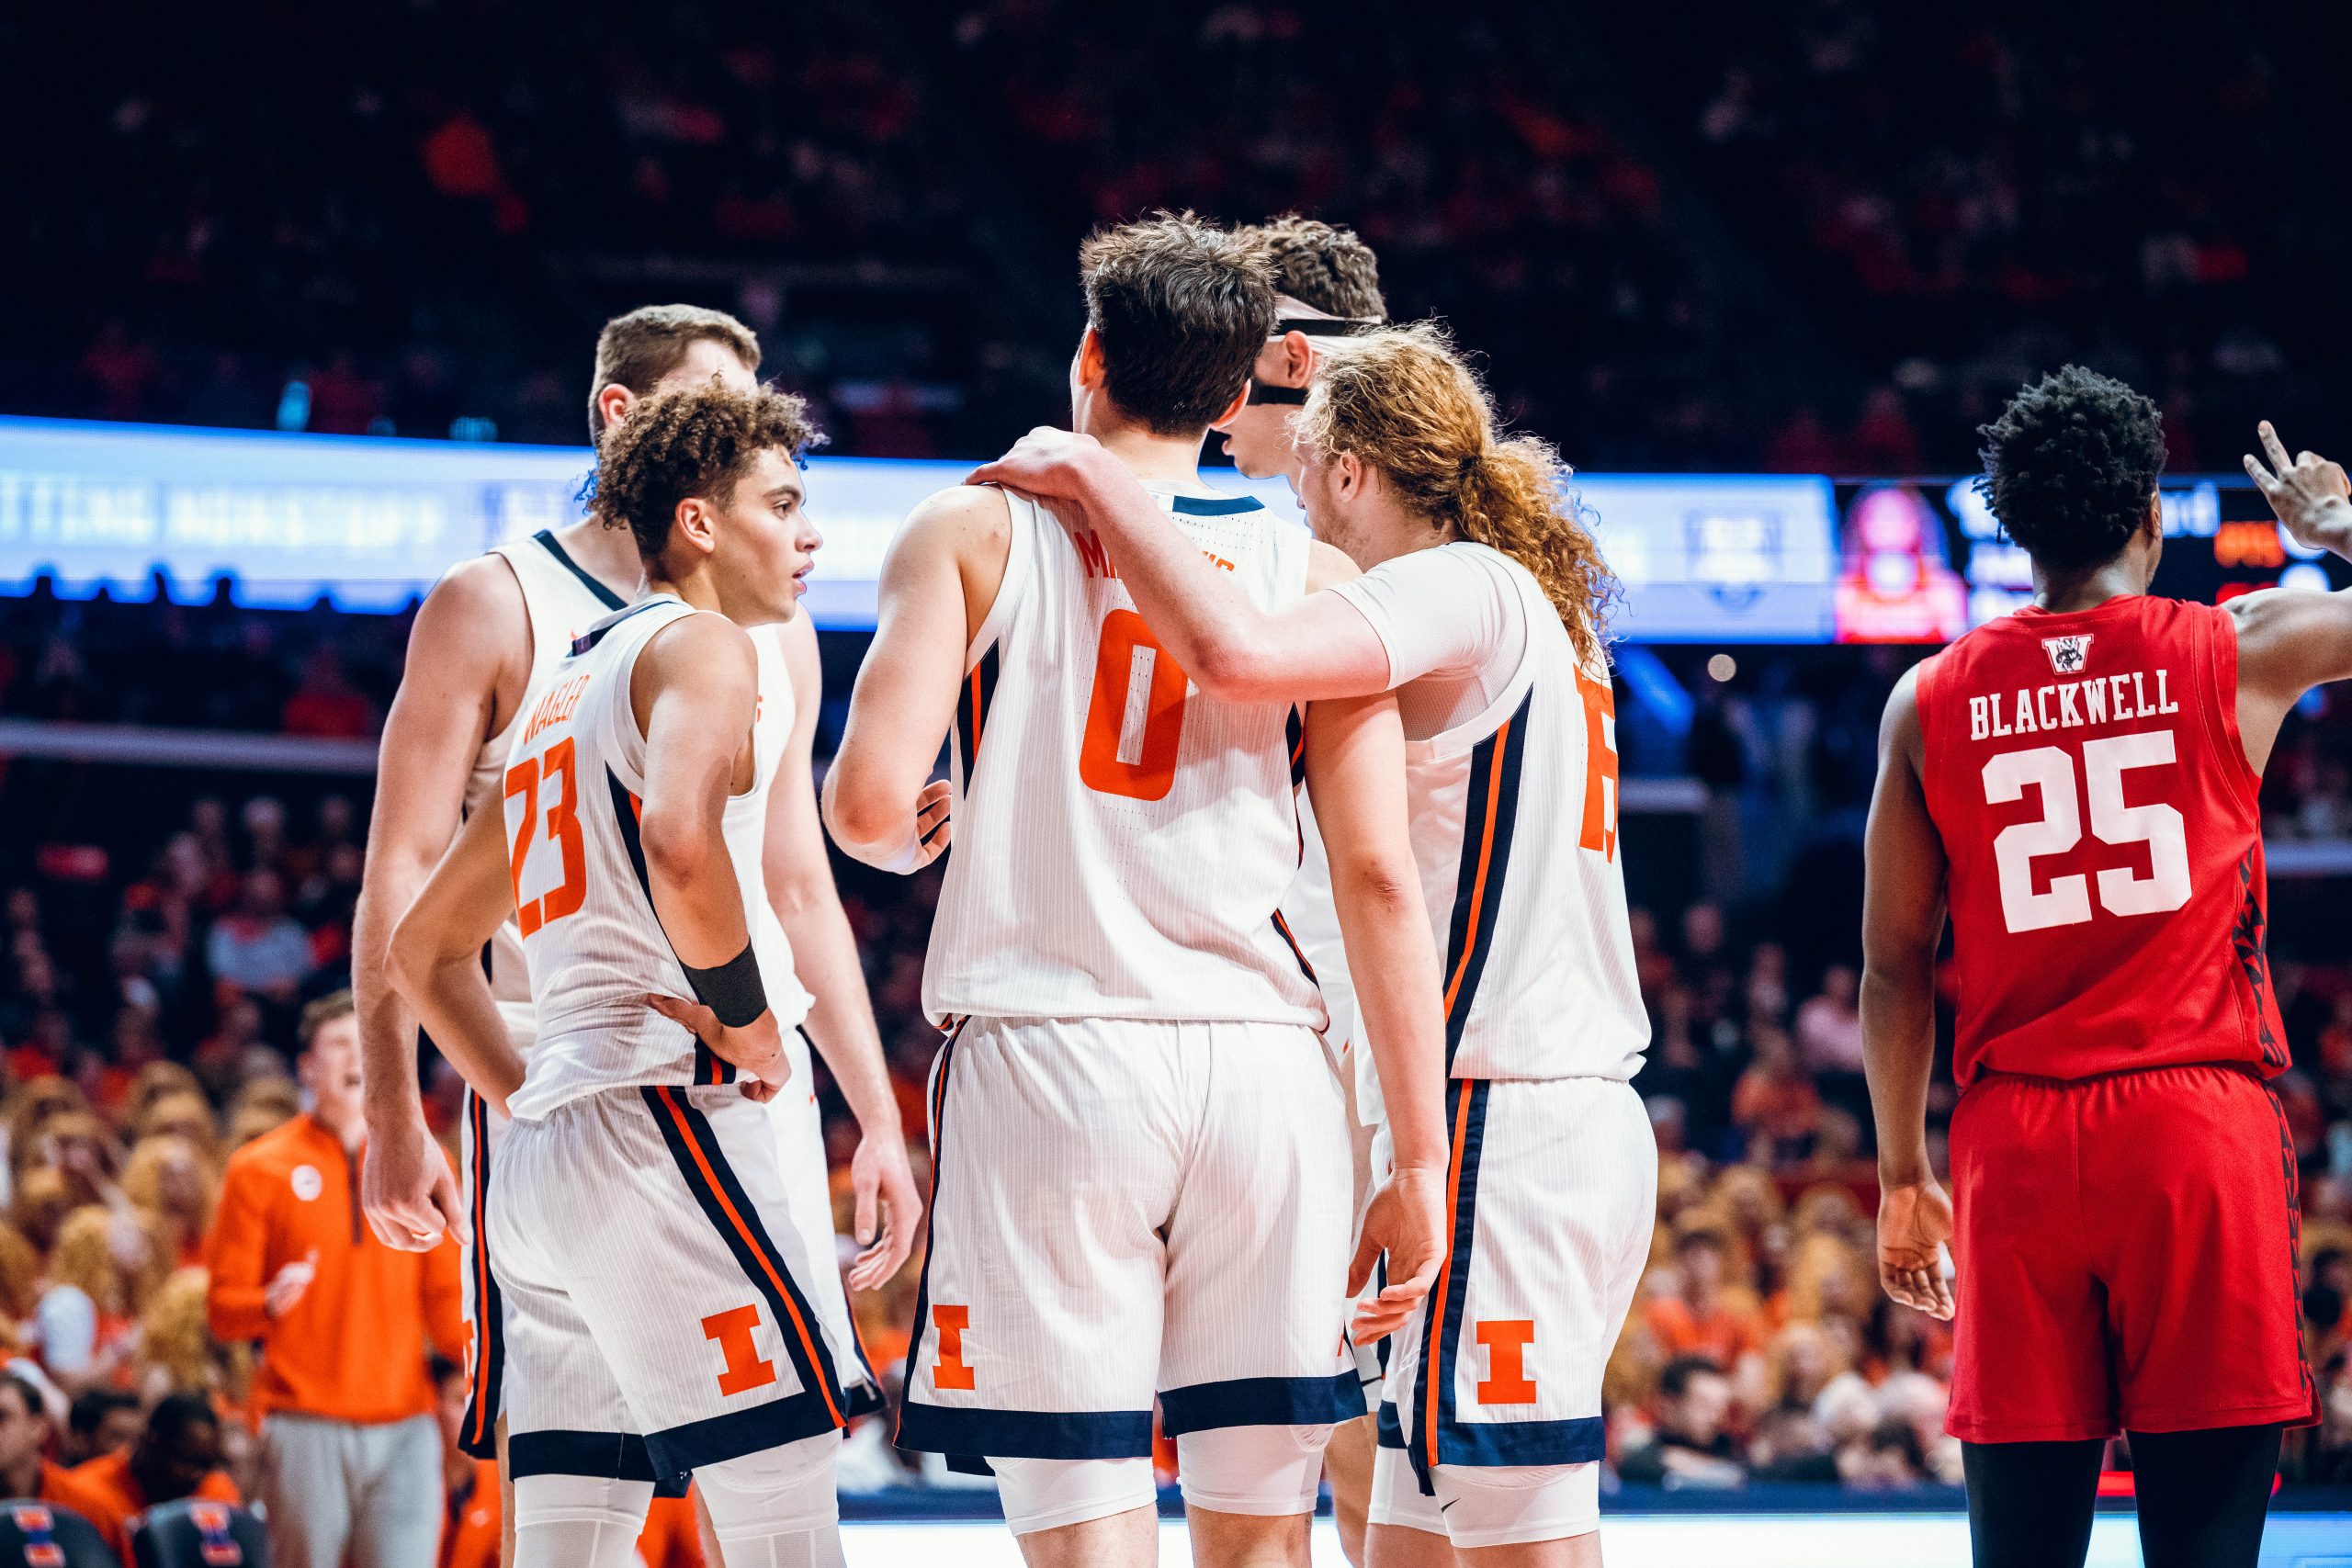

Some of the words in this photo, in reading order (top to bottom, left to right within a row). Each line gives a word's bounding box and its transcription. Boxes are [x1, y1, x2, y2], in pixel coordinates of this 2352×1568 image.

[1080, 609, 1188, 801] 0
[1970, 670, 2178, 741] BLACKWELL
[504, 737, 586, 940] 23
[1982, 730, 2193, 933] 25
[701, 1303, 776, 1397] I
[933, 1304, 975, 1390] I
[1476, 1320, 1536, 1404] I
